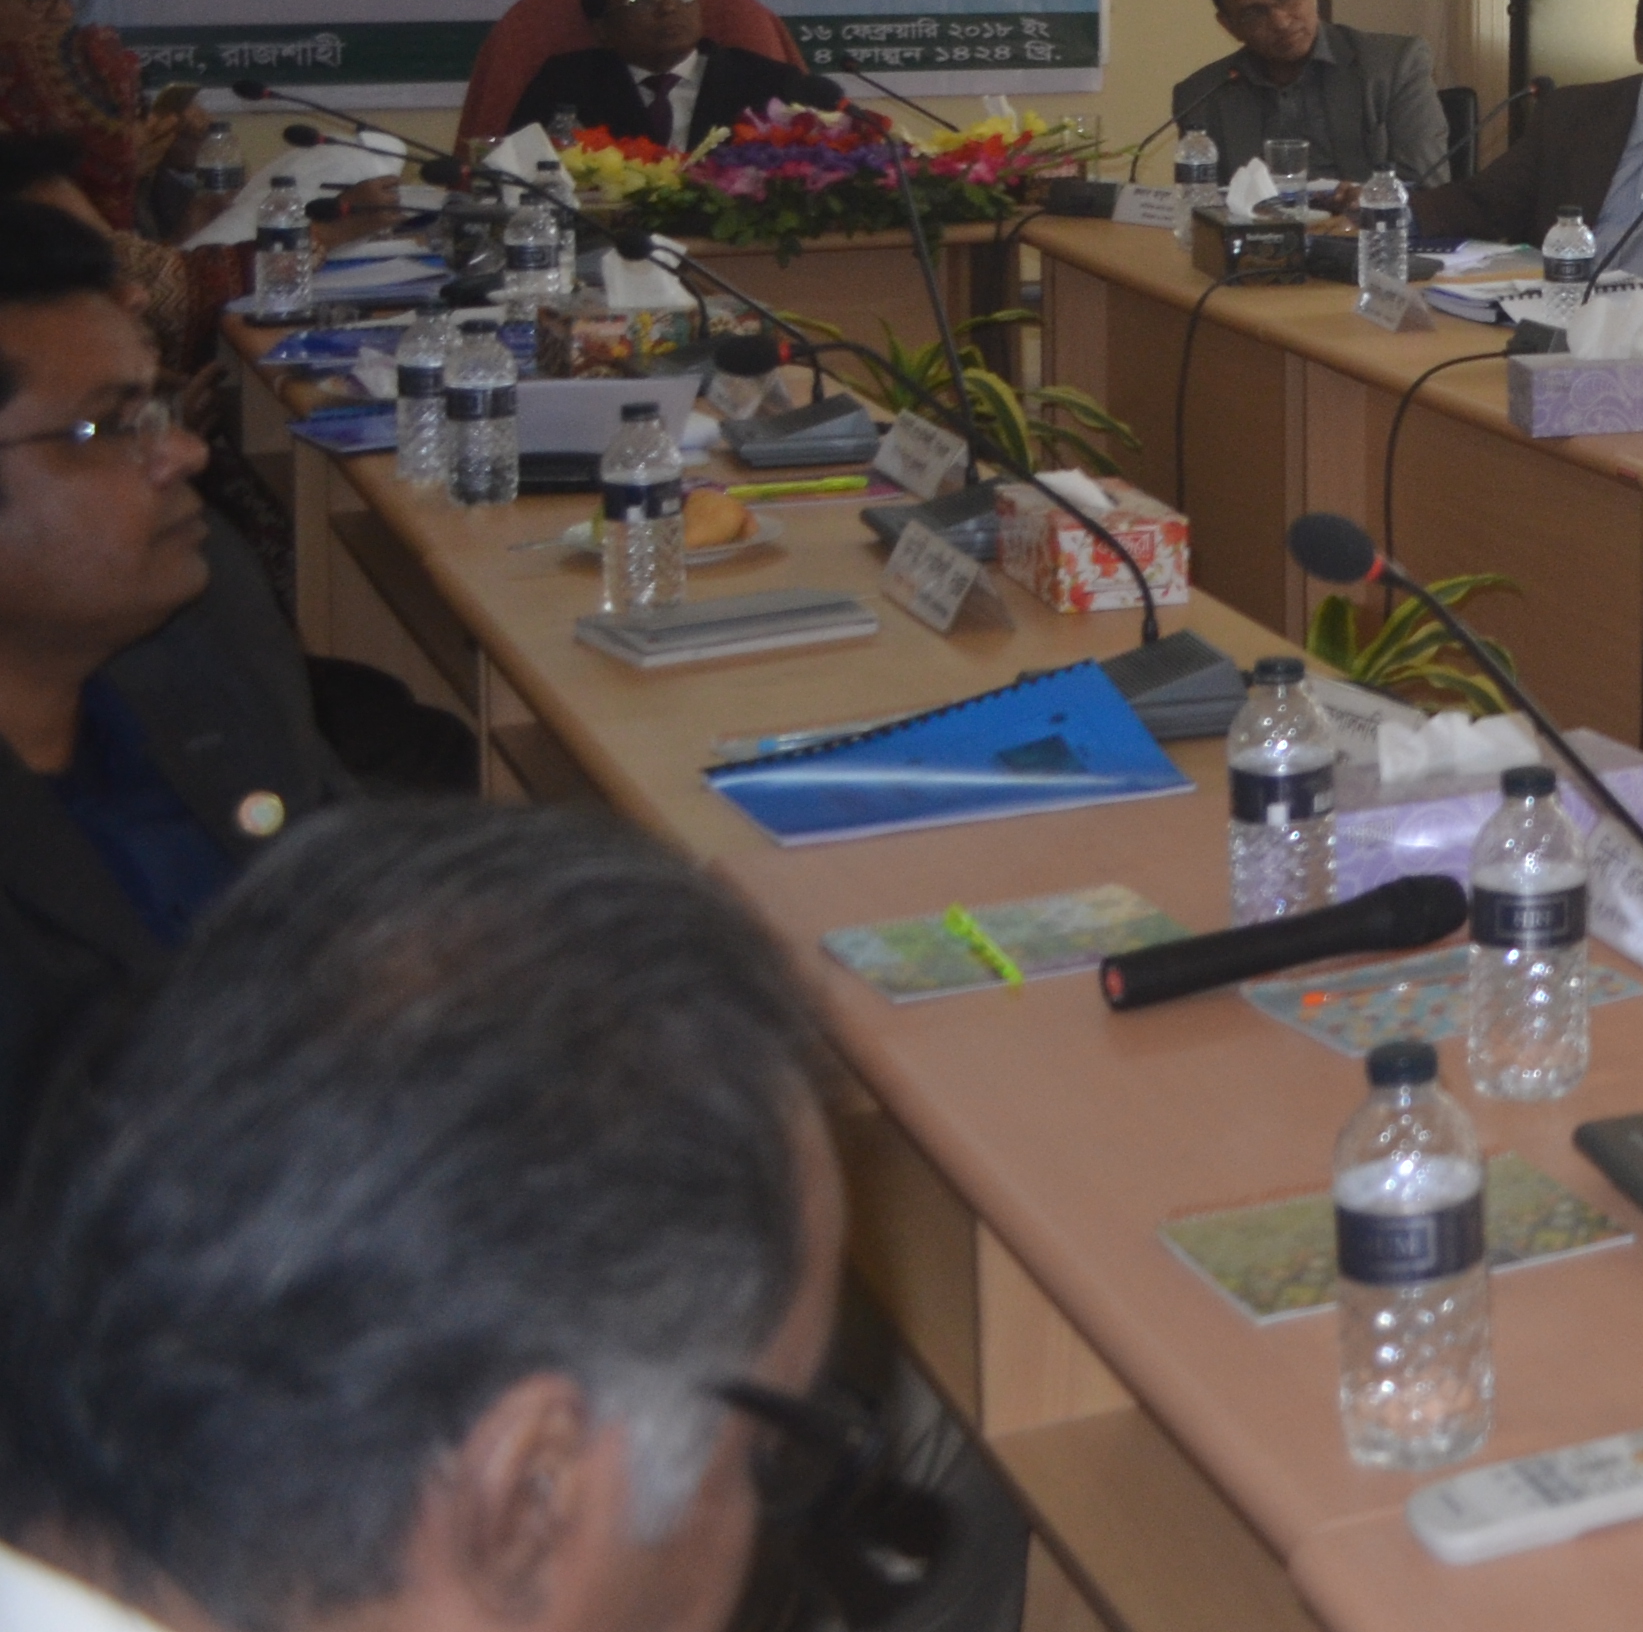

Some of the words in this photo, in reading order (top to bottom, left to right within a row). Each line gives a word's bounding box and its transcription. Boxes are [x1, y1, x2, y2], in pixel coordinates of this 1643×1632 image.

[799, 24, 833, 42] ১৬
[947, 24, 1014, 40] ২০১৮
[219, 30, 348, 70] রাজশাহী
[934, 44, 1012, 63] ১৪২৪
